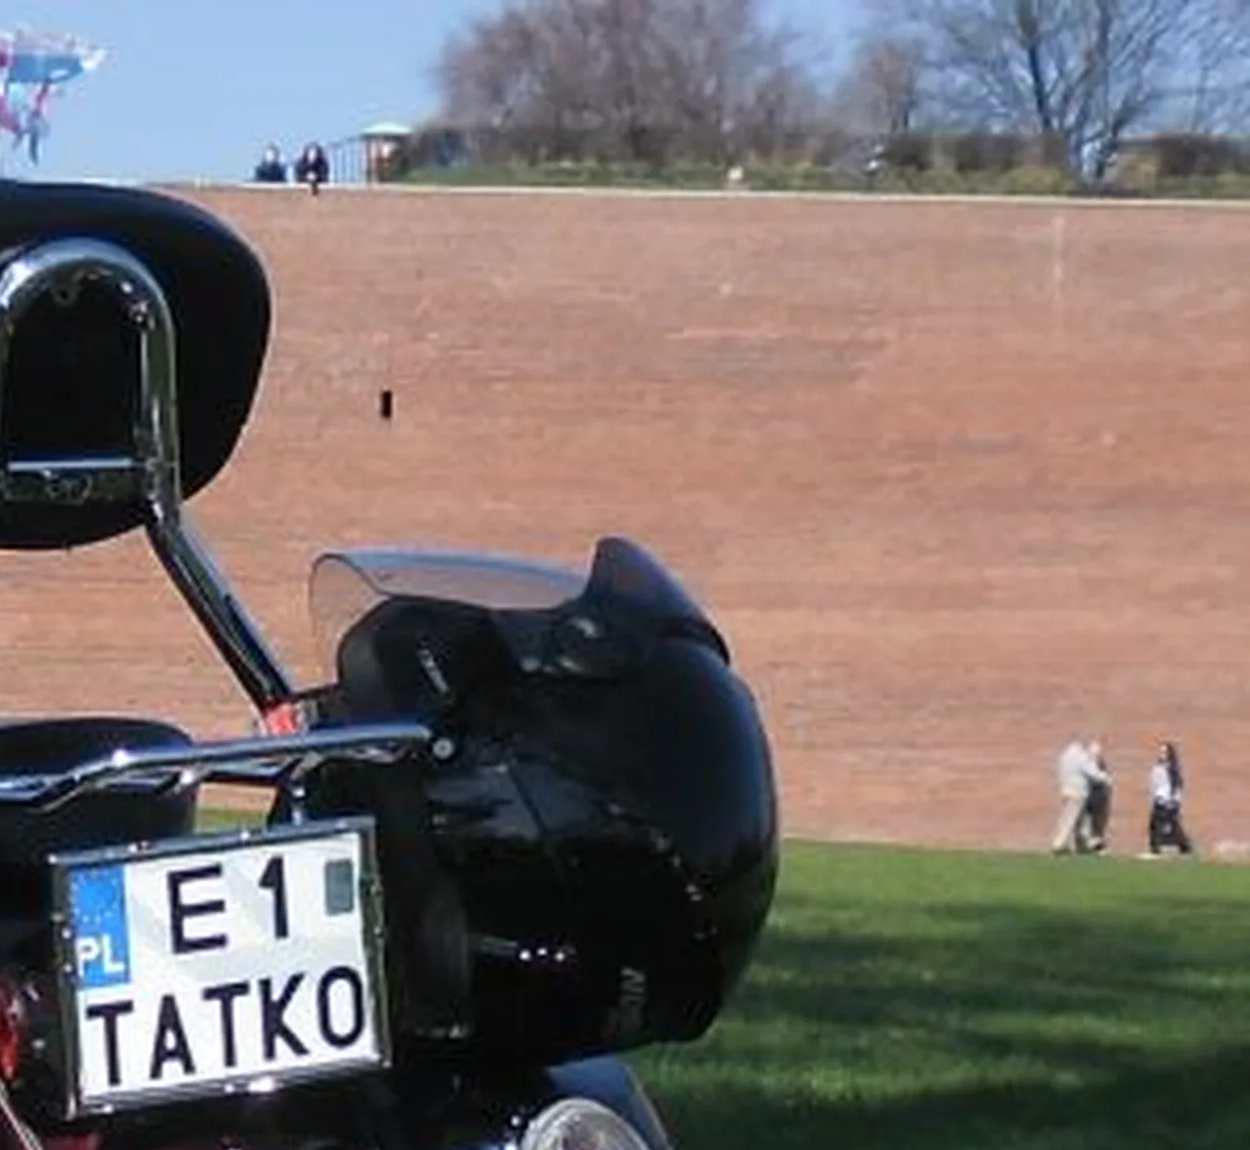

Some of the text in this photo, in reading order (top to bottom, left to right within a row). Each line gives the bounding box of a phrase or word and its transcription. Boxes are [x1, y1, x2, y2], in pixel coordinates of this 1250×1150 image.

[167, 855, 289, 954] E1
[76, 933, 125, 977] PL
[85, 966, 366, 1087] TATKO
